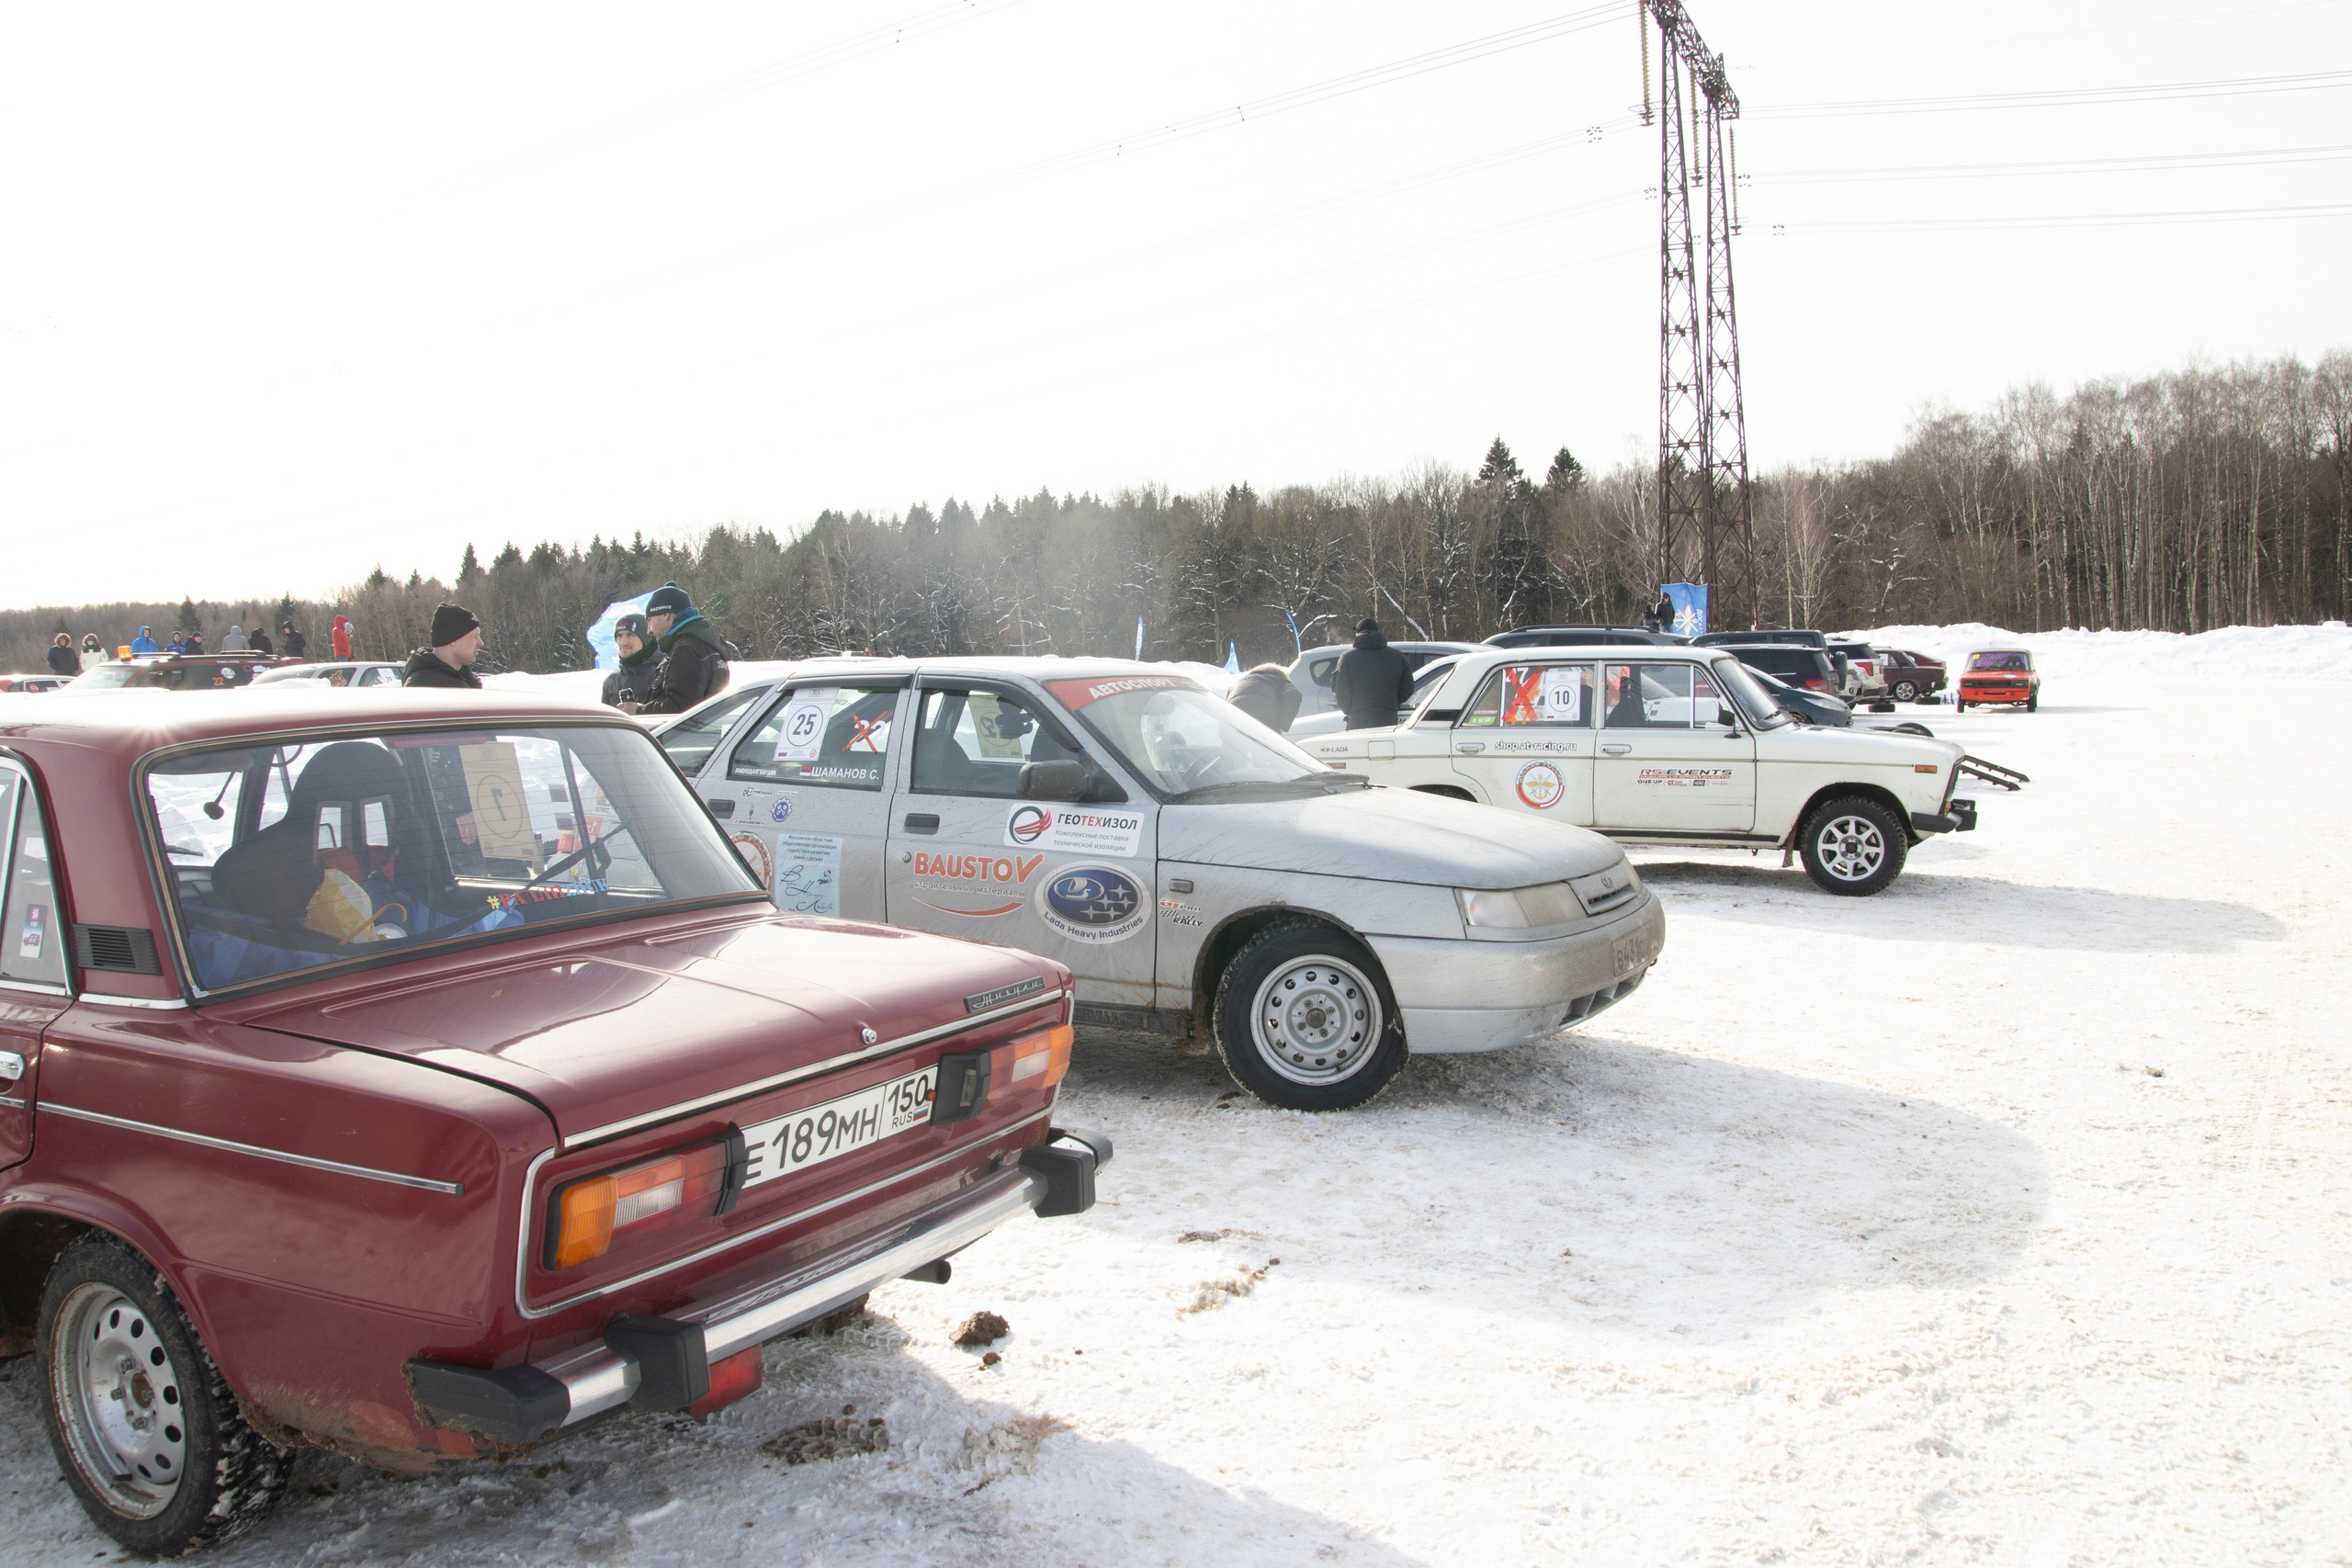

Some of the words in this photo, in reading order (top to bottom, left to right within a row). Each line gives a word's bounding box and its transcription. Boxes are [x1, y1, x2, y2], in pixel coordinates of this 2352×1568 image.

[1088, 677, 1176, 699] АВТОСПОРТ
[1555, 691, 1570, 705] 10
[793, 714, 817, 736] 25
[1495, 740, 1577, 753] shop.at-racing.ru
[810, 766, 866, 779] ШАМАНОВ
[869, 770, 879, 780] С.
[1057, 813, 1138, 830] ГЕОТЕХИЗОЛ
[1055, 829, 1098, 840] Комплексные
[1099, 833, 1129, 841] поставки
[1053, 840, 1093, 849] технической
[1093, 842, 1125, 852] изоляции
[913, 852, 1045, 884] BAUSTOV
[913, 880, 974, 894] Строительные
[977, 886, 1026, 898] материалы
[1043, 911, 1065, 931] Lada
[1067, 925, 1097, 941] Heavy
[1098, 916, 1144, 939] Industries
[1172, 918, 1203, 927] RALLY
[972, 981, 1044, 1009] Жигули
[888, 1074, 929, 1116] 150
[891, 1112, 913, 1130] RUS
